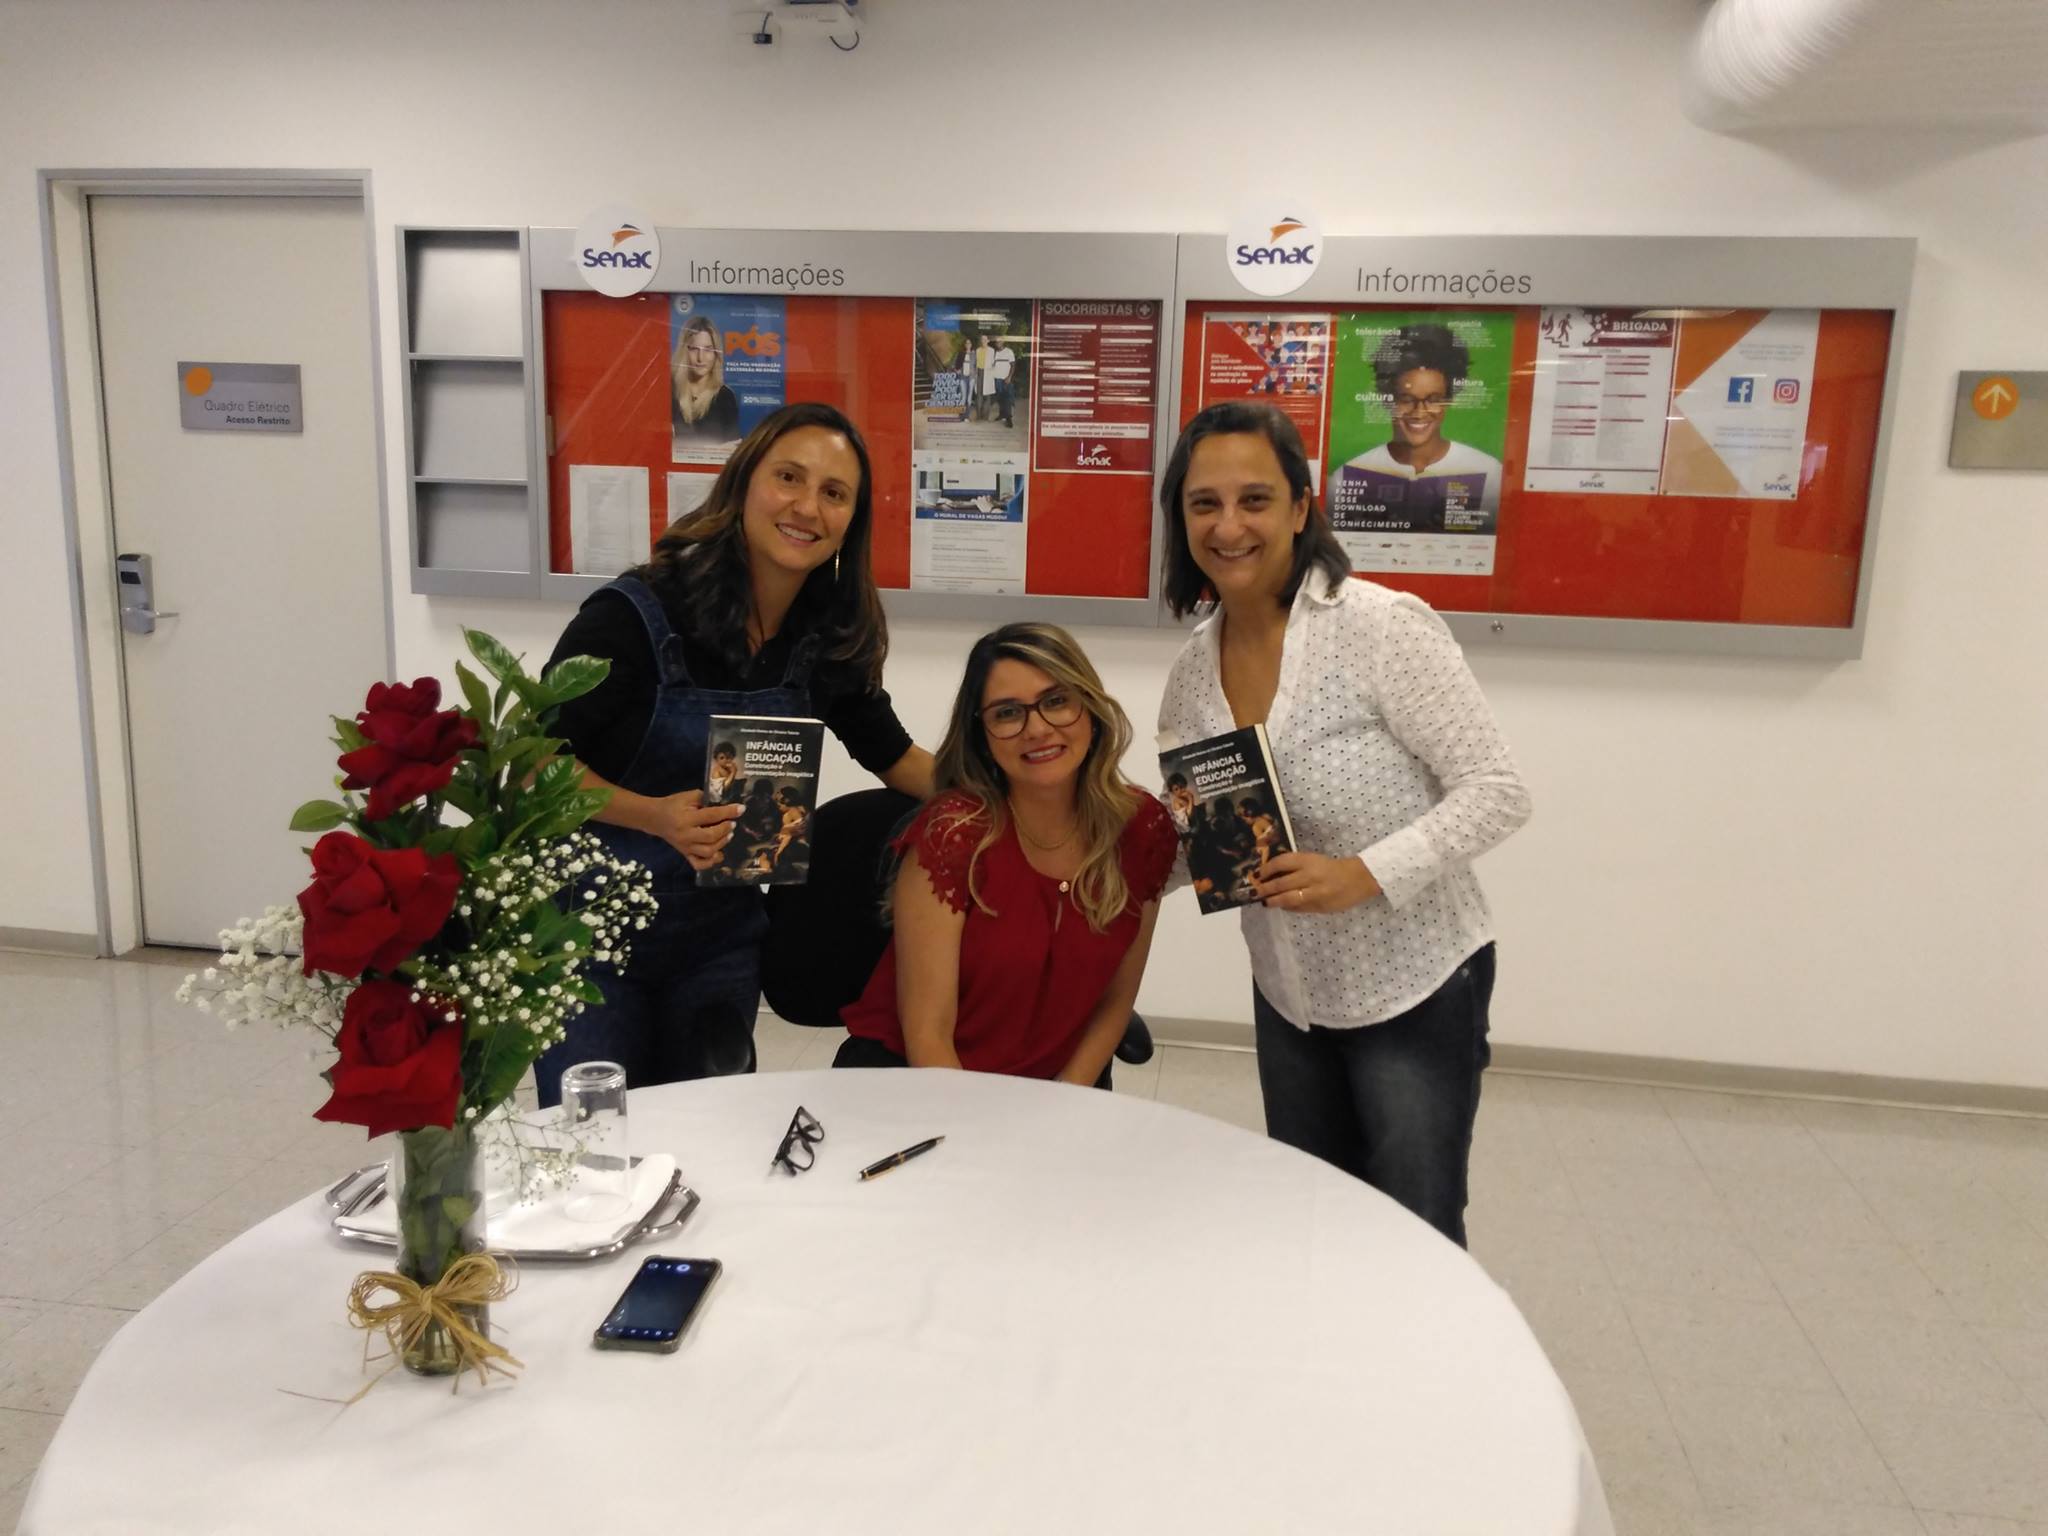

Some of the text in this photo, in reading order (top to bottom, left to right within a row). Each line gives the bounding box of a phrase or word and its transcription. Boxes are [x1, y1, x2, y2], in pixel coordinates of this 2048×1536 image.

[583, 248, 652, 269] Senac
[1236, 245, 1314, 266] Senac
[690, 260, 845, 291] Informações
[1356, 267, 1532, 298] Informações
[1045, 303, 1133, 315] SOCORRISTAS
[1355, 327, 1401, 336] tolerância
[1612, 321, 1668, 331] BRIGADA
[724, 324, 781, 356] PÓS
[1453, 378, 1483, 387] leitura
[1355, 392, 1394, 402] cultura
[204, 400, 290, 413] Quadro Elétrico
[226, 415, 290, 425] Acesso Restrito
[1334, 504, 1386, 512] DOWNLOAD
[1333, 520, 1411, 529] CONHECIMENTO
[746, 740, 802, 752] INFÂNCIA E
[745, 753, 801, 764] EDUCAÇÃO
[1192, 752, 1244, 775] INFÂNCIA E
[1195, 764, 1247, 786] EDUCAÇÃO
